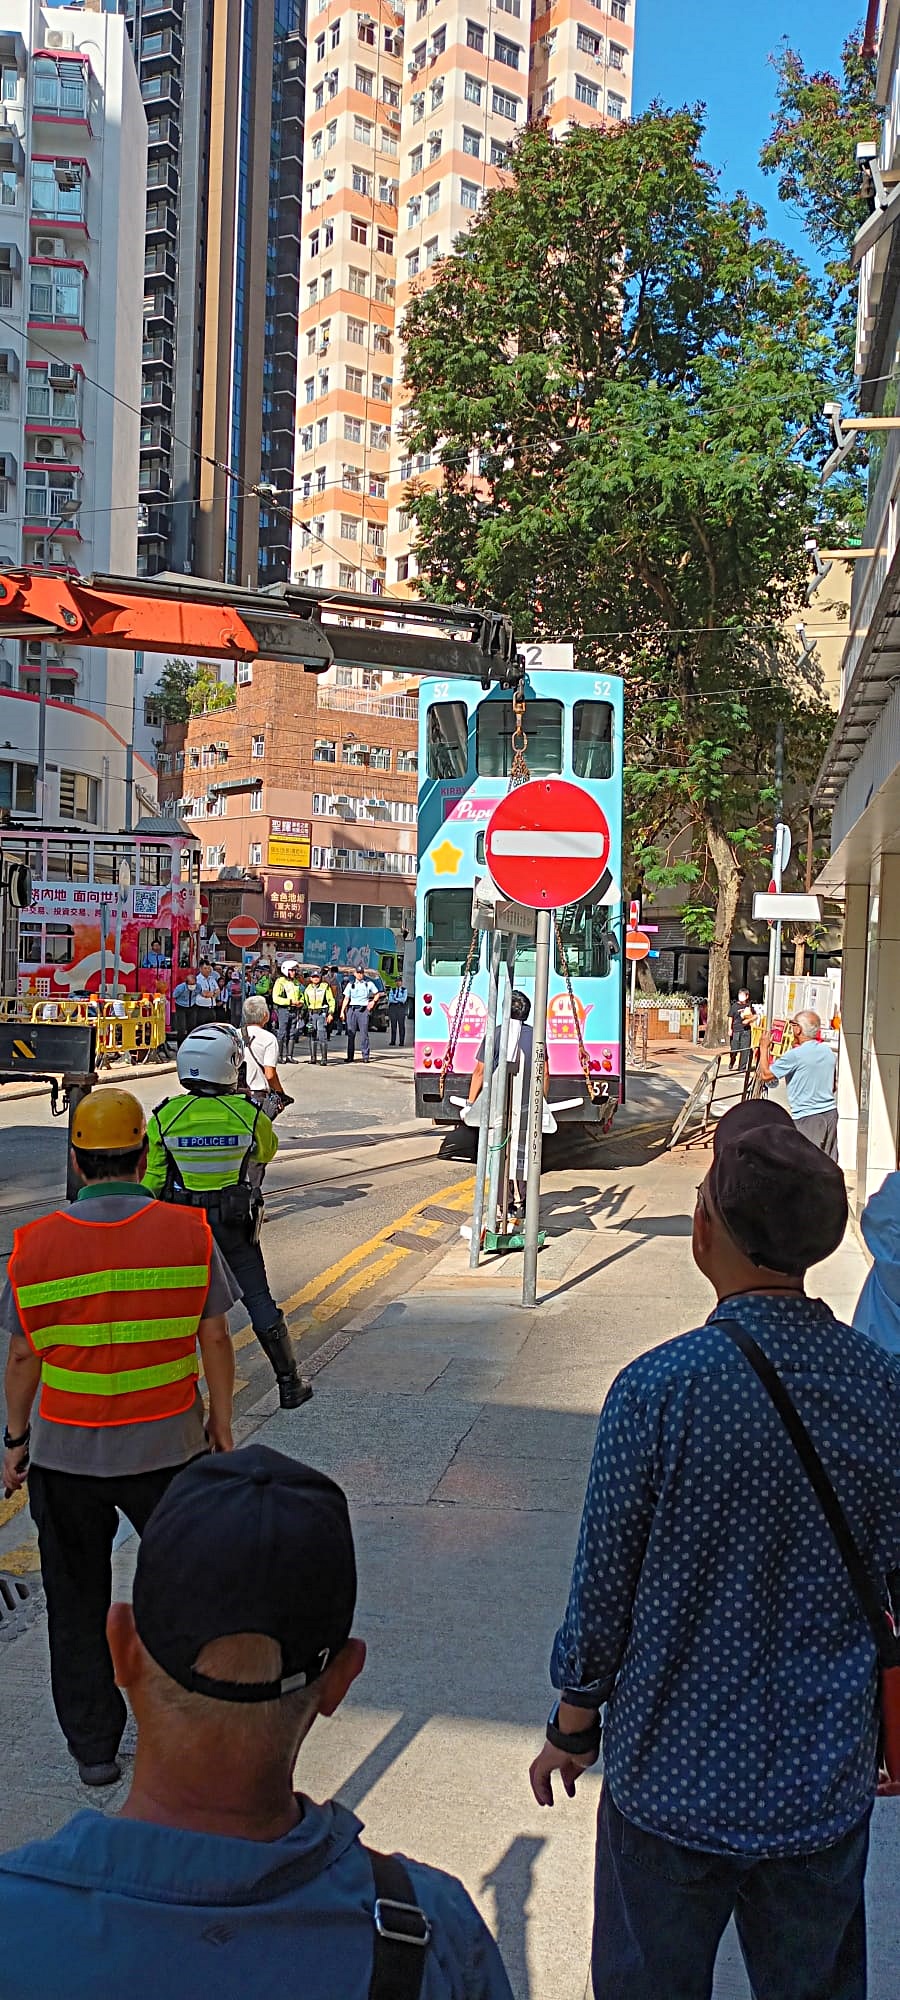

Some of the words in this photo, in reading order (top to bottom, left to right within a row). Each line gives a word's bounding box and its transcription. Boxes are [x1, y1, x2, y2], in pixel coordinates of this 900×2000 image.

[433, 684, 449, 698] 52
[593, 682, 612, 697] 52
[593, 1081, 609, 1096] 52
[191, 1137, 226, 1147] POLICE
